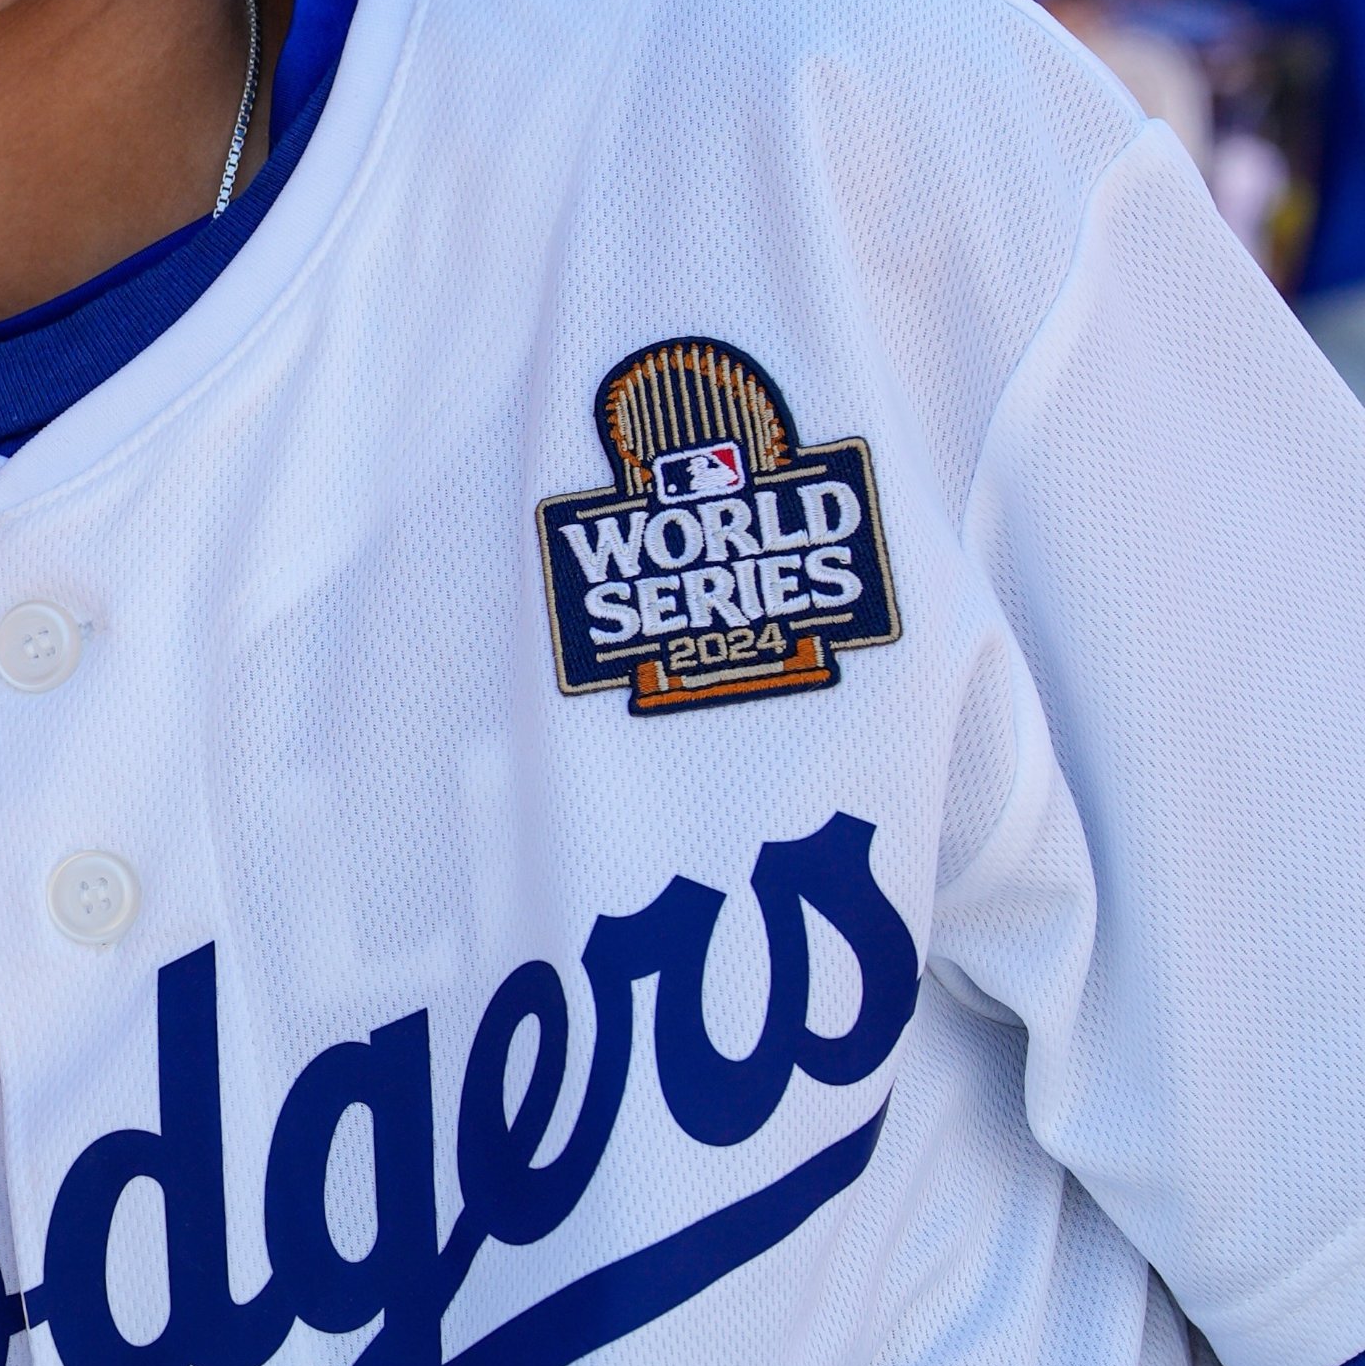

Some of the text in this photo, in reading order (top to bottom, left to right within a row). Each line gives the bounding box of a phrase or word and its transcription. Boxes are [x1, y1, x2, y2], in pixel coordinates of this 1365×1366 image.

[557, 480, 862, 584] WORLD
[583, 546, 864, 646] SERIES
[669, 623, 787, 671] 2024
